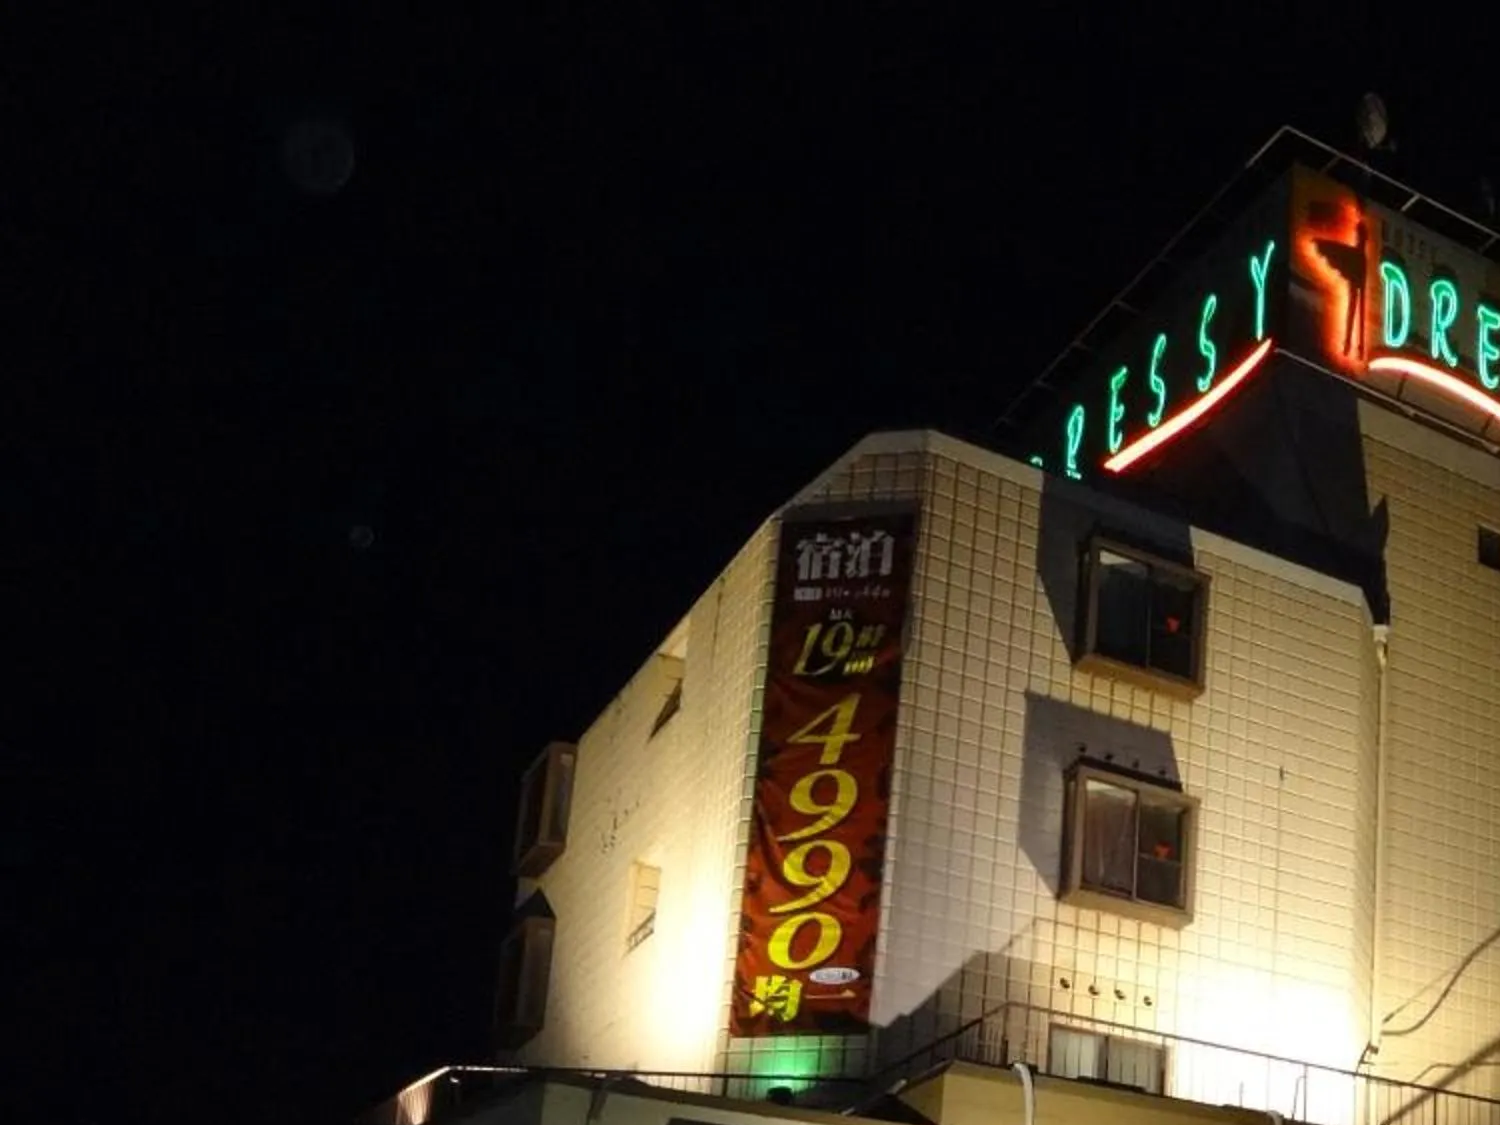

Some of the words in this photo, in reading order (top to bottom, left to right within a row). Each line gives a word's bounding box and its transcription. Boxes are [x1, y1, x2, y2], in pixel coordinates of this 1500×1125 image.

[1030, 240, 1274, 479] RESSY
[796, 530, 895, 581] 宿泊
[767, 692, 861, 970] 4990
